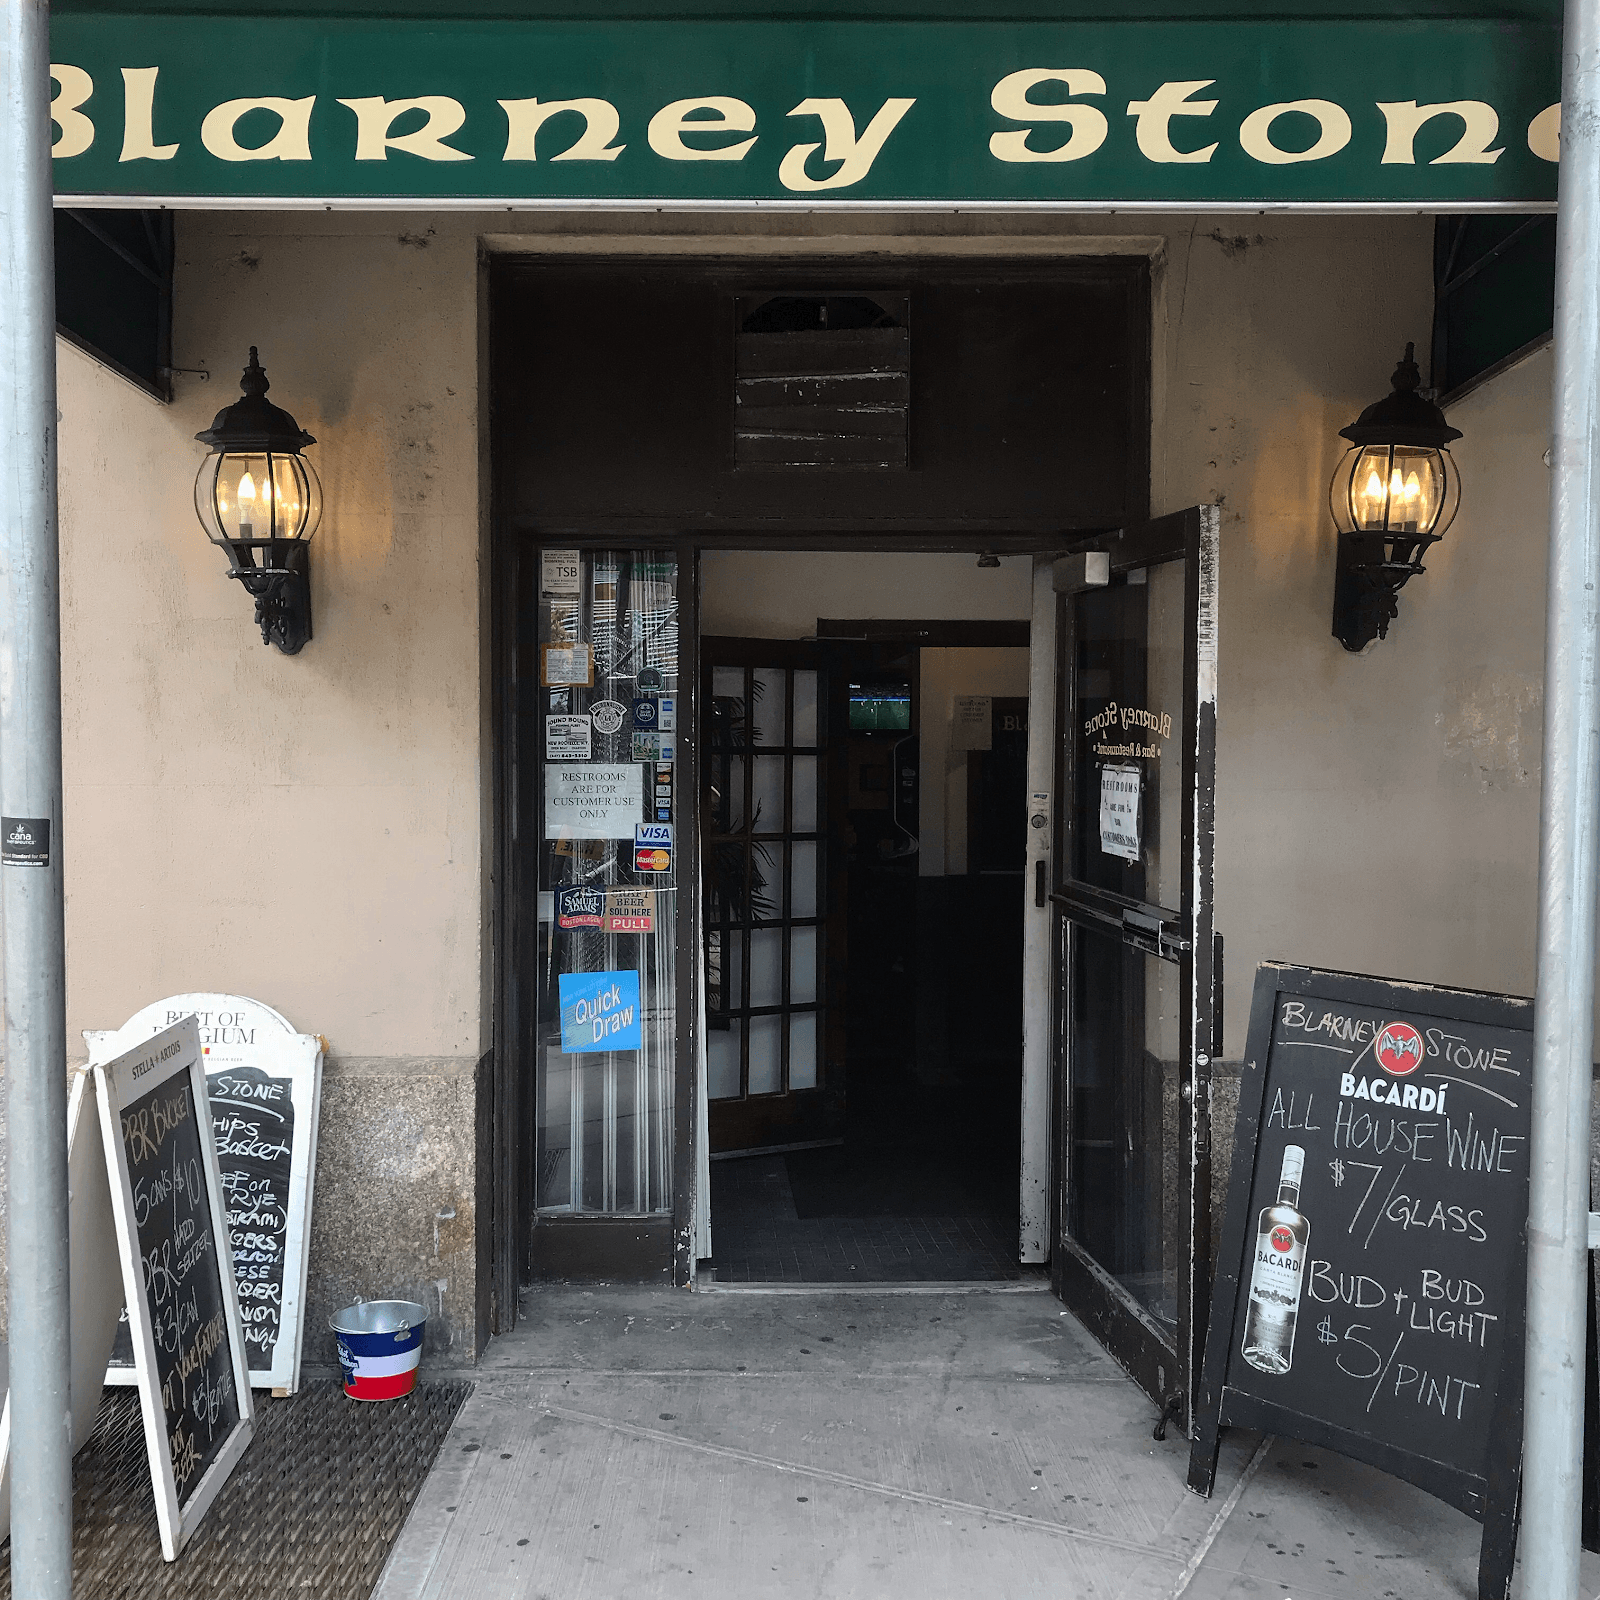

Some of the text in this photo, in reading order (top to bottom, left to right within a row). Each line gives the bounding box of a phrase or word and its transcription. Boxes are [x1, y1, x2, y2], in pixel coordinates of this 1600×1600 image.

[50, 63, 917, 192] Blarney
[555, 566, 578, 578] TSB
[561, 772, 627, 782] RESTROOMS
[571, 785, 617, 794] ARE FOR
[553, 797, 635, 807] CUSTOMER USE
[579, 809, 609, 819] ONLY
[10, 832, 31, 841] cana
[640, 827, 670, 839] VISA
[636, 856, 670, 864] MasterCard
[564, 896, 600, 906] SAMUEL
[567, 903, 598, 914] ADAMS
[616, 898, 645, 907] BEER
[609, 908, 651, 916] SOLD HERE
[612, 919, 649, 929] PULL
[575, 982, 621, 1025] Quick
[218, 1010, 246, 1027] OF
[592, 1004, 634, 1044] Draw
[1281, 1001, 1521, 1076] BLARNEY STONE
[131, 1039, 181, 1080] STELLA ARTOIS
[214, 1075, 285, 1101] STONE
[211, 1112, 261, 1140] HIPS
[1267, 1086, 1526, 1173] ALL HOUSE WINE
[220, 1170, 271, 1192] EF on
[229, 1228, 278, 1251] GERS
[234, 1265, 271, 1280] ESE
[1308, 1259, 1387, 1308] BUD
[1421, 1268, 1486, 1306] BUD
[236, 1279, 282, 1306] GER
[1409, 1302, 1498, 1348] LIGHT
[162, 1369, 176, 1412] OT
